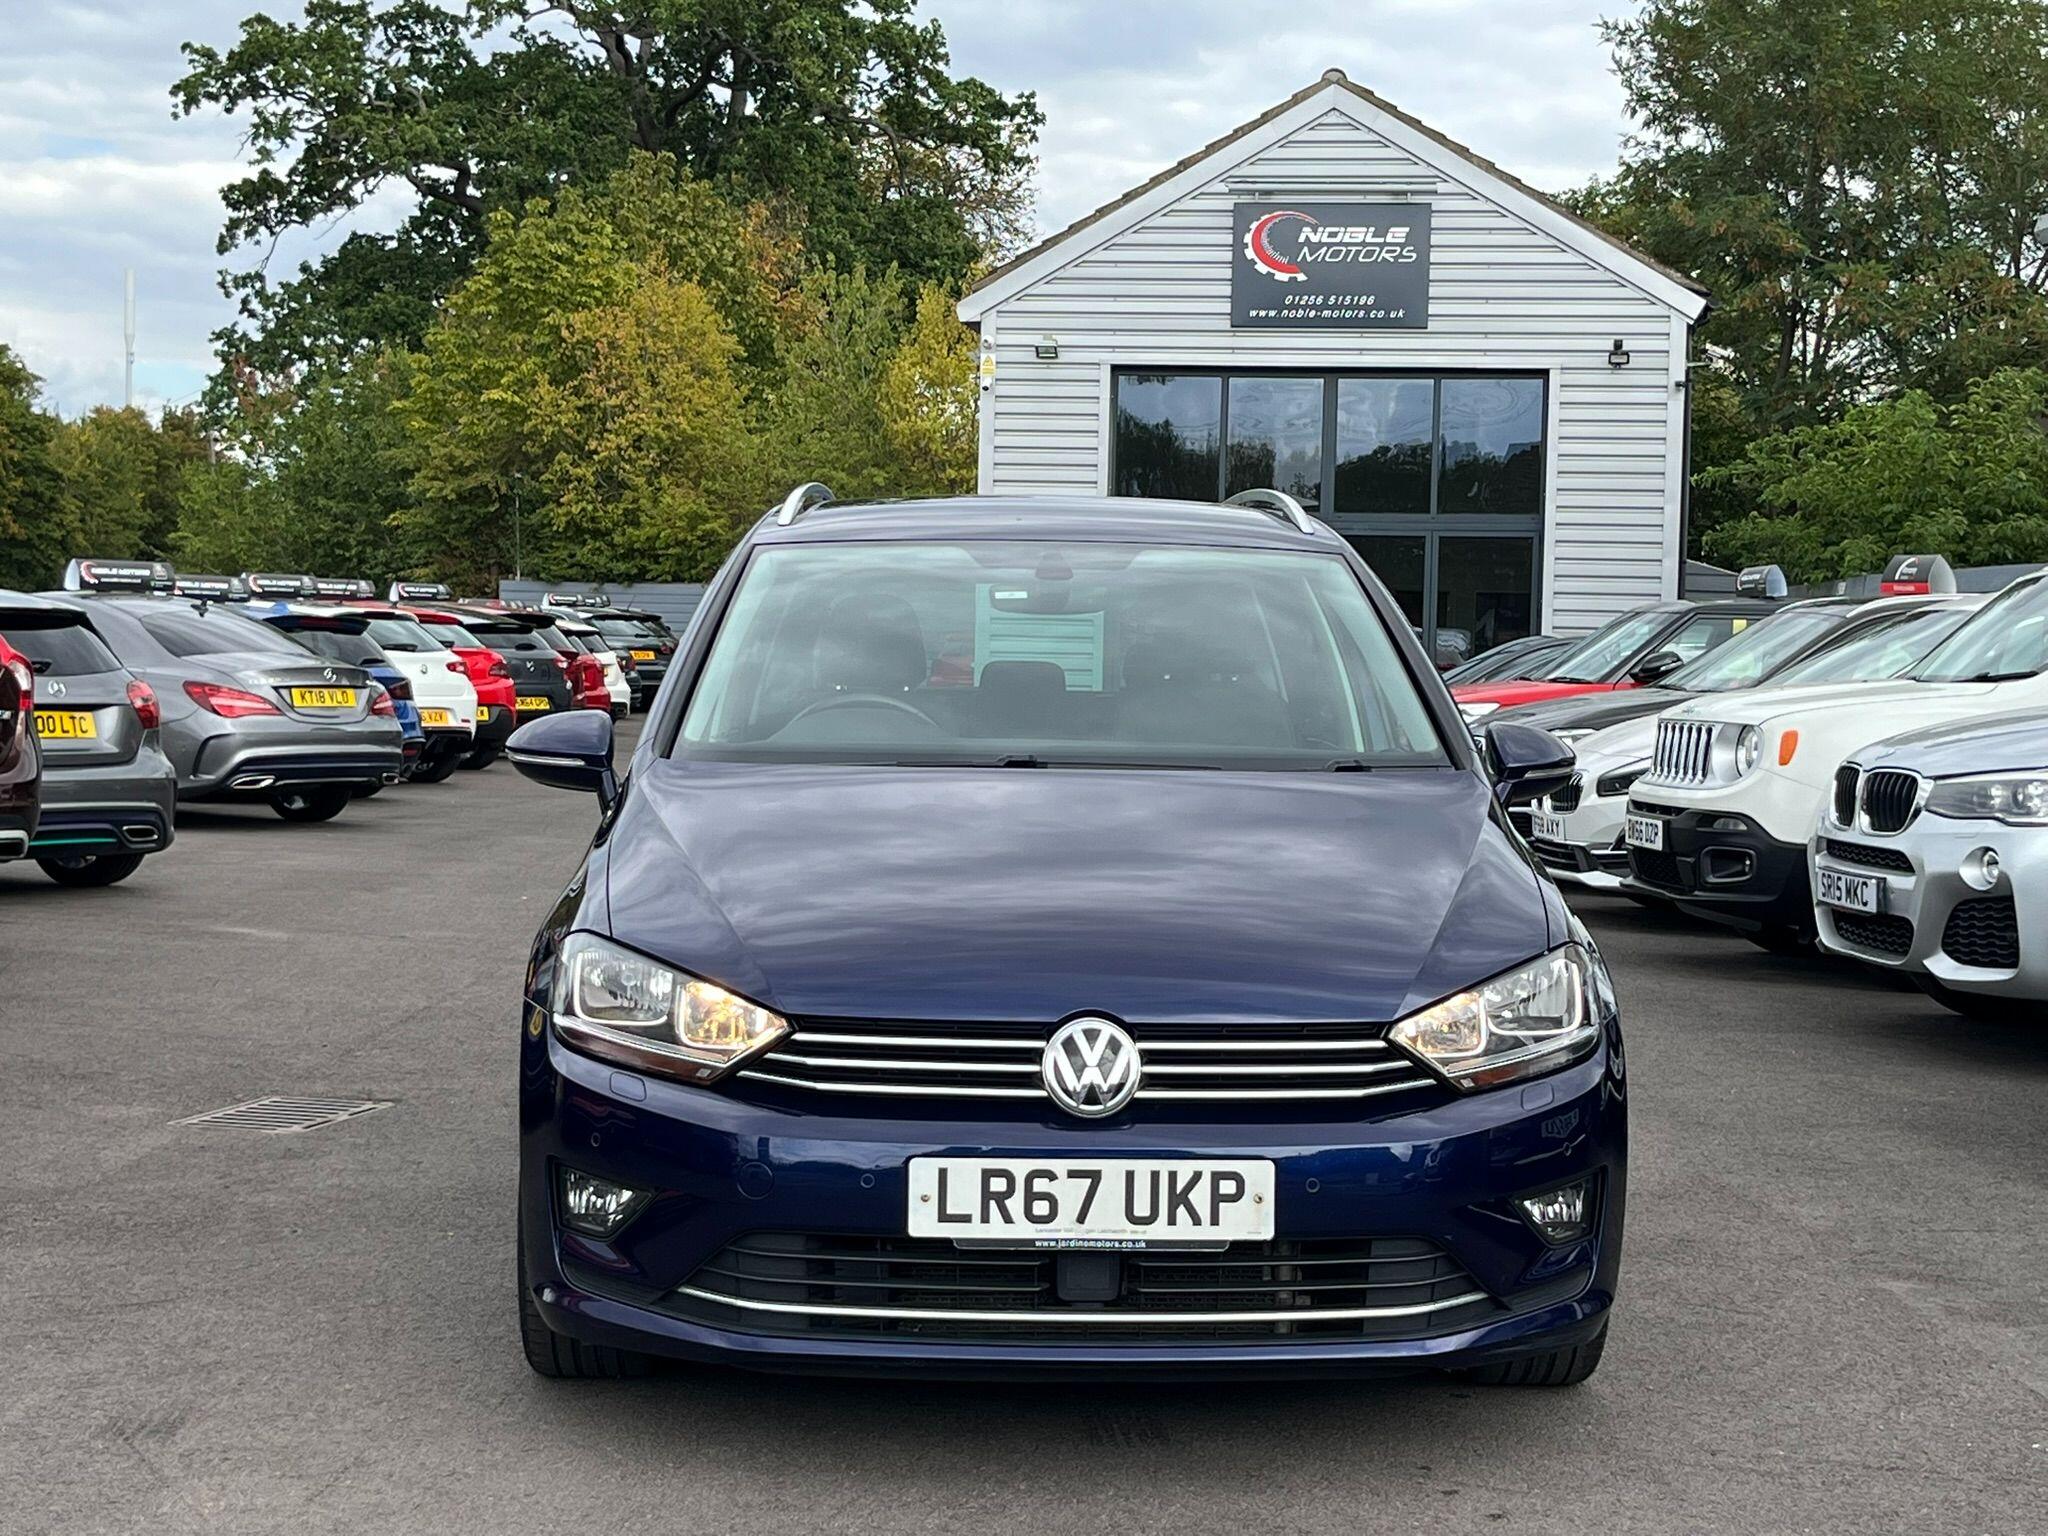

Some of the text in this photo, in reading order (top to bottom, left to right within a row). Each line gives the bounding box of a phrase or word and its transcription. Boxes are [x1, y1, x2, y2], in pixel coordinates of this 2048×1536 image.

[1298, 226, 1410, 243] NOBLE
[1297, 246, 1417, 263] MOTORS
[1284, 294, 1323, 306] 01256
[1249, 307, 1406, 319] www.noble-motors.co.uk
[300, 690, 325, 704] KT18
[60, 715, 89, 734] LTC
[1821, 872, 1843, 902] SR15
[937, 1167, 1246, 1227] LR67 UKP
